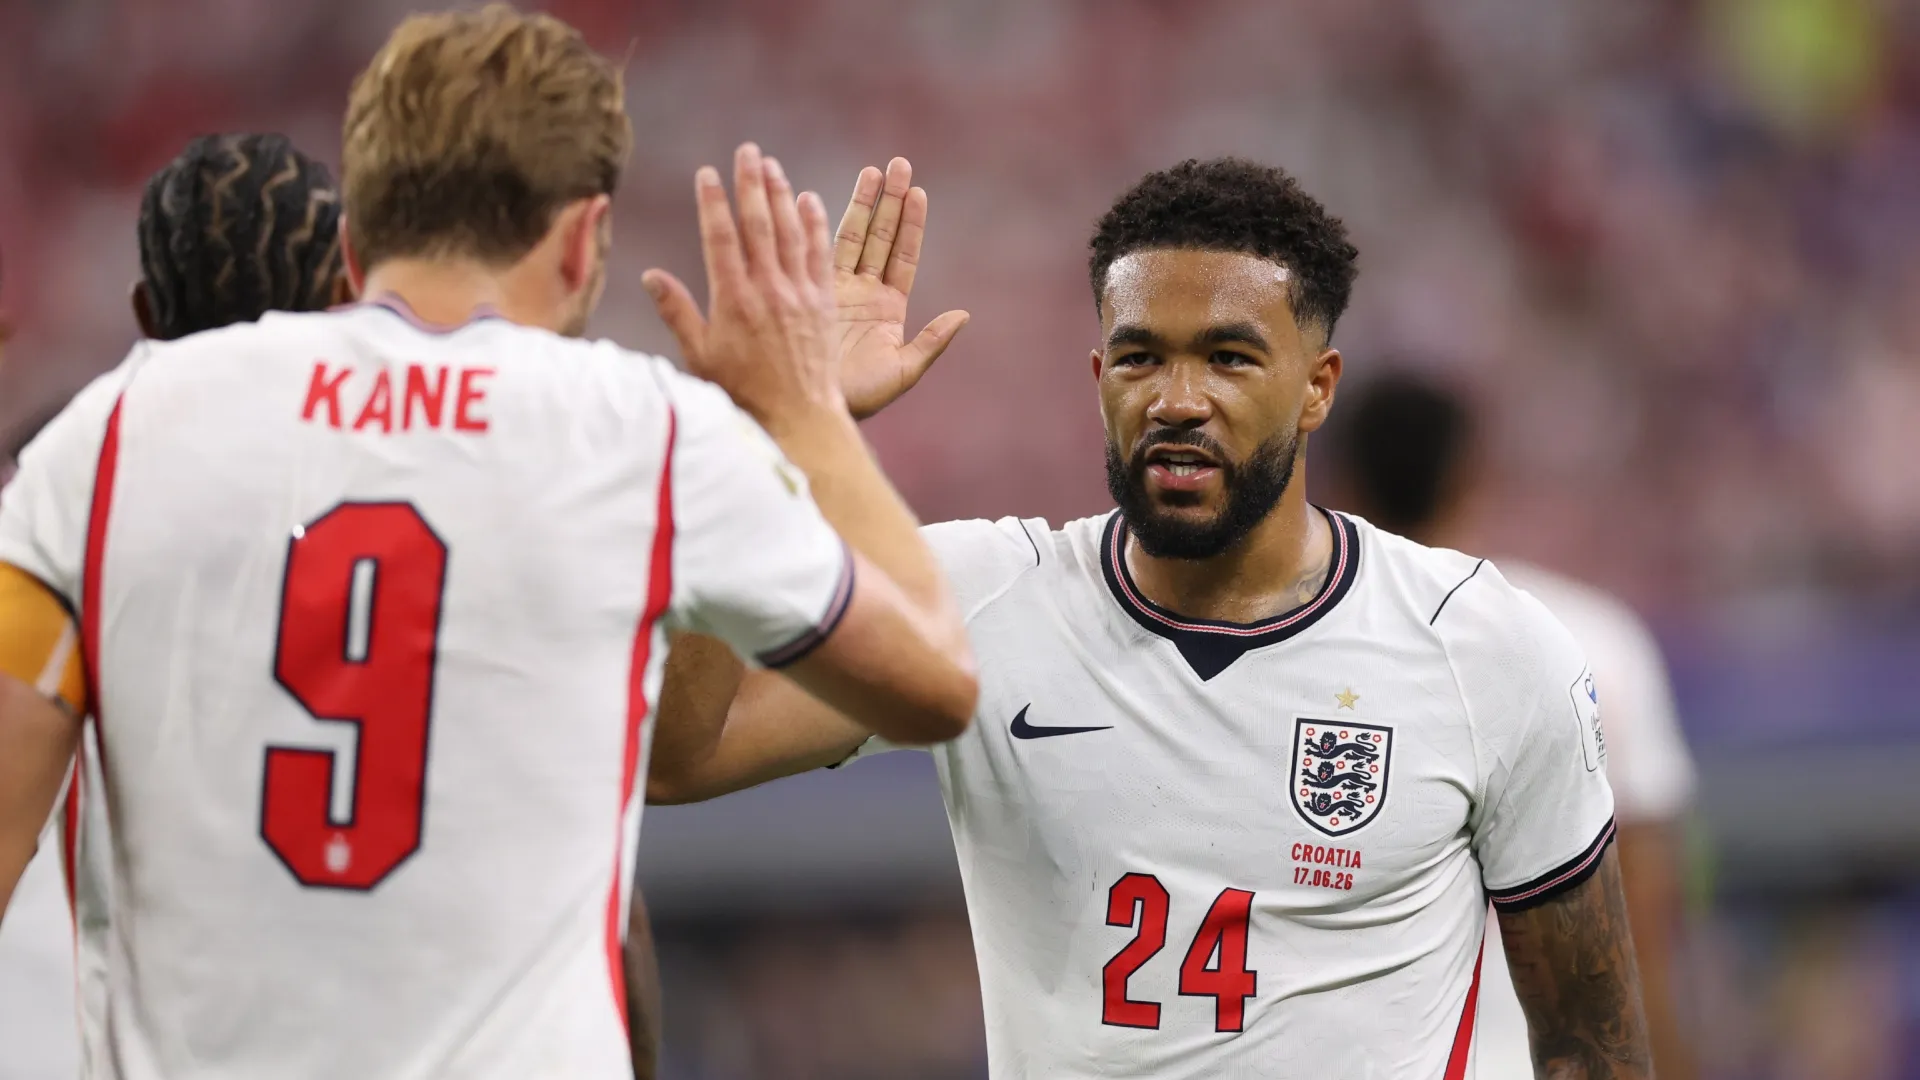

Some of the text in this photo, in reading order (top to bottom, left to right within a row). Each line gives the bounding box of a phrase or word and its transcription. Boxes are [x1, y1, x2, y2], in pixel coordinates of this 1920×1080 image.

[300, 361, 496, 435] KANE
[259, 499, 450, 890] 9
[1291, 843, 1362, 868] CROATIA
[1293, 867, 1353, 890] 17.06.26
[1102, 872, 1257, 1033] 24
